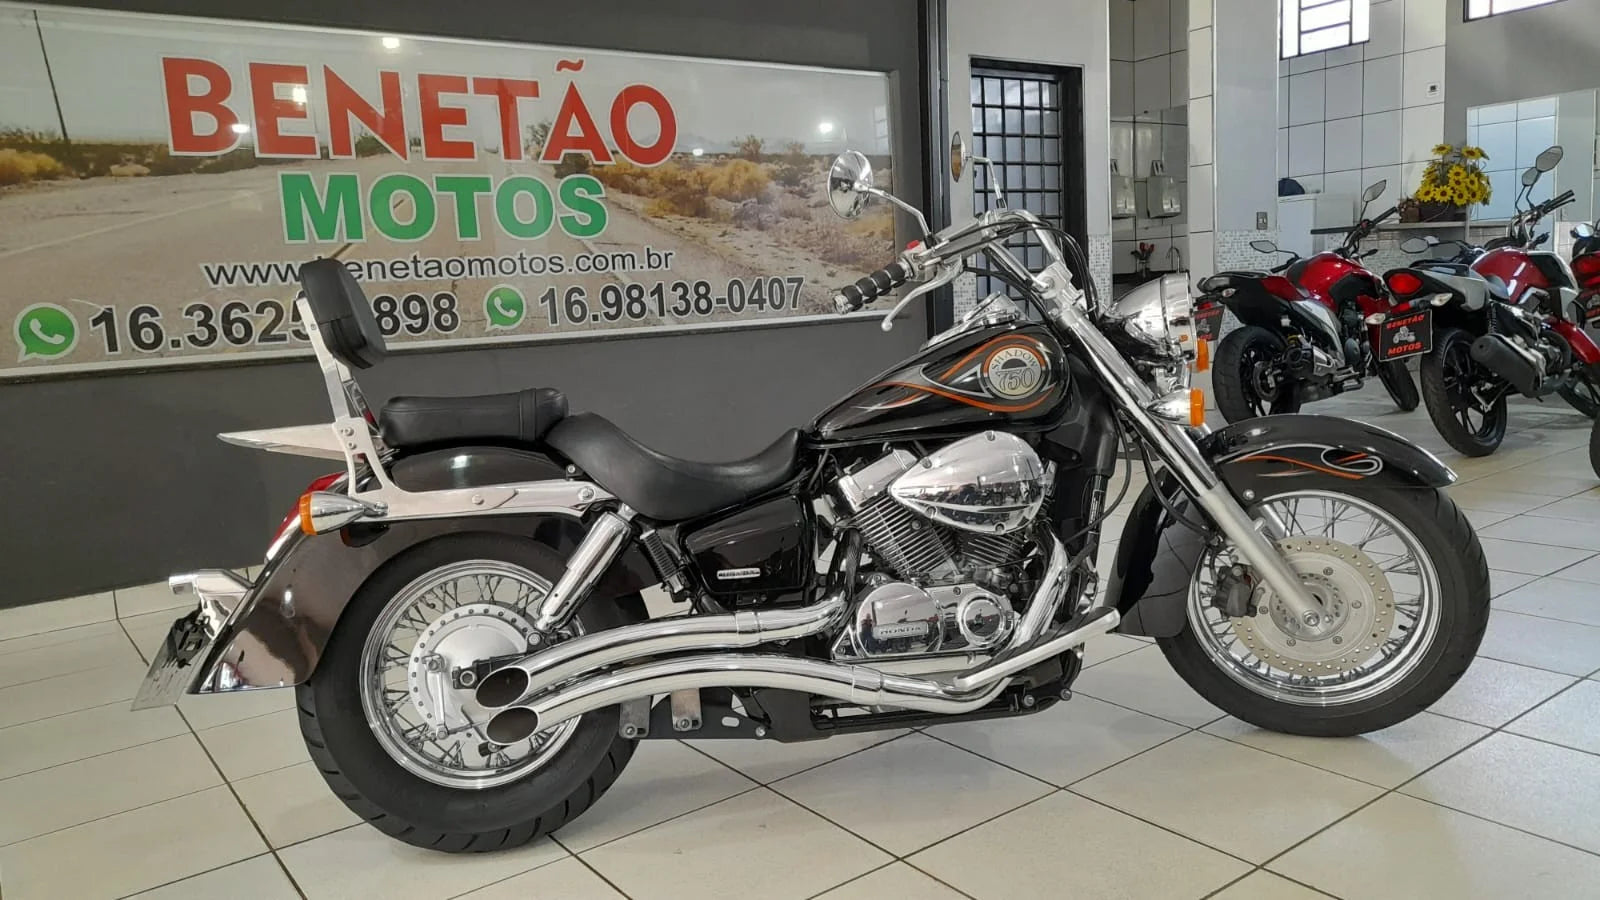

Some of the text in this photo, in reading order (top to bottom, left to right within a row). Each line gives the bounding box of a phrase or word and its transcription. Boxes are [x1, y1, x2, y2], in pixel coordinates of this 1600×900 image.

[162, 57, 678, 166] BENETÃO
[280, 173, 608, 242] MOTOS
[204, 247, 673, 286] wwwenetaomotos.com.br
[540, 276, 805, 325] 16.98138-0407
[991, 349, 1038, 370] SHADOW
[1387, 342, 1422, 355] MOTOS
[995, 367, 1035, 392] 750
